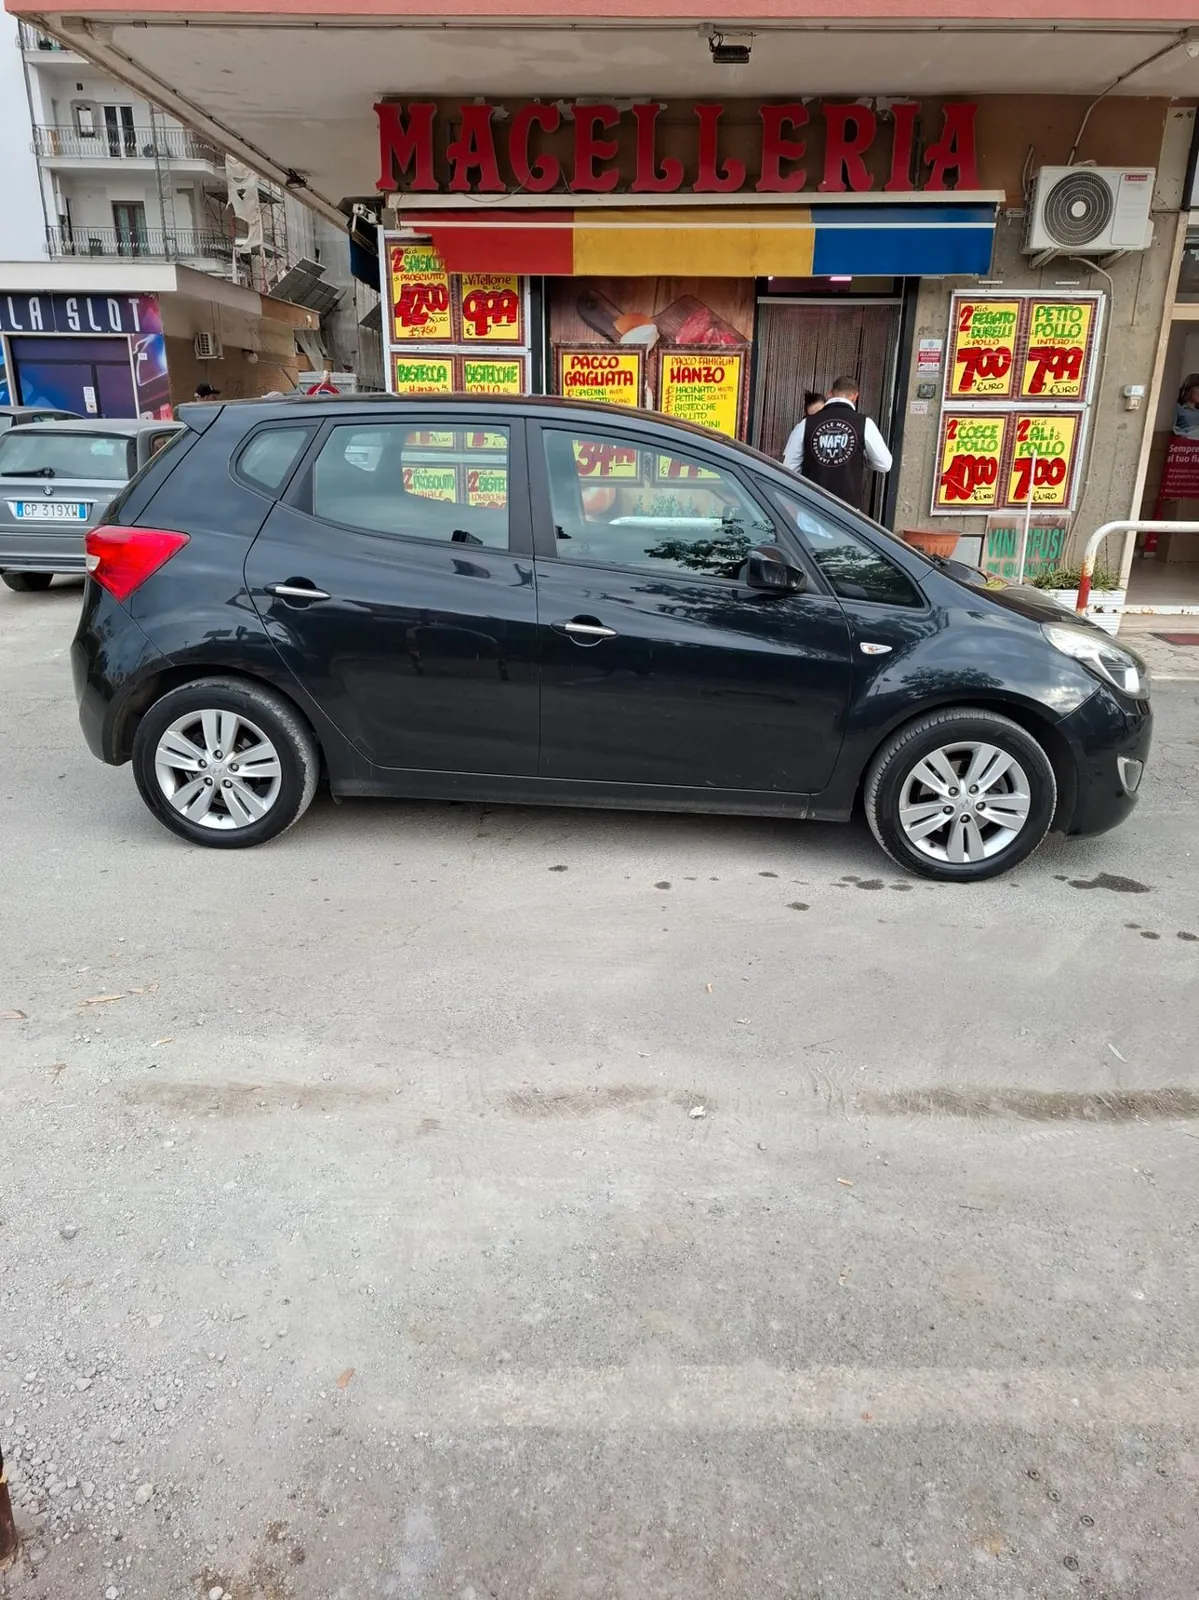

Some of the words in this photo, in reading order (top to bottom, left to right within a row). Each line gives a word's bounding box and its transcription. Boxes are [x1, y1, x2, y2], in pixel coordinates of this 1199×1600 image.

[373, 101, 981, 193] MACELLERIA
[66, 297, 141, 332] SLOT
[960, 305, 974, 332] 2
[972, 311, 1016, 325] FEGATO
[1035, 306, 1083, 322] PETTO
[1034, 322, 1082, 338] POLLO
[571, 355, 620, 369] PACCO
[671, 356, 697, 366] PACCO
[397, 363, 448, 384] BISTECCA
[465, 363, 519, 384] BISTECCHE
[564, 370, 634, 387] GRIGLIATA
[575, 388, 607, 397] SPIEDINI
[674, 394, 705, 403] FETTINE
[674, 402, 717, 412] BISTECCHE
[816, 422, 834, 436] STYLE
[836, 422, 852, 434] MEAT
[947, 419, 959, 440] 2
[958, 425, 999, 439] COSCE
[1017, 419, 1031, 442] 2
[1029, 426, 1055, 441] ALI
[956, 439, 998, 453] POLLO
[1019, 440, 1065, 456] POLLO
[1169, 444, 1199, 455] Sempre
[1175, 455, 1189, 463] tuo
[24, 502, 38, 516] CP
[42, 503, 78, 517] 319XW
